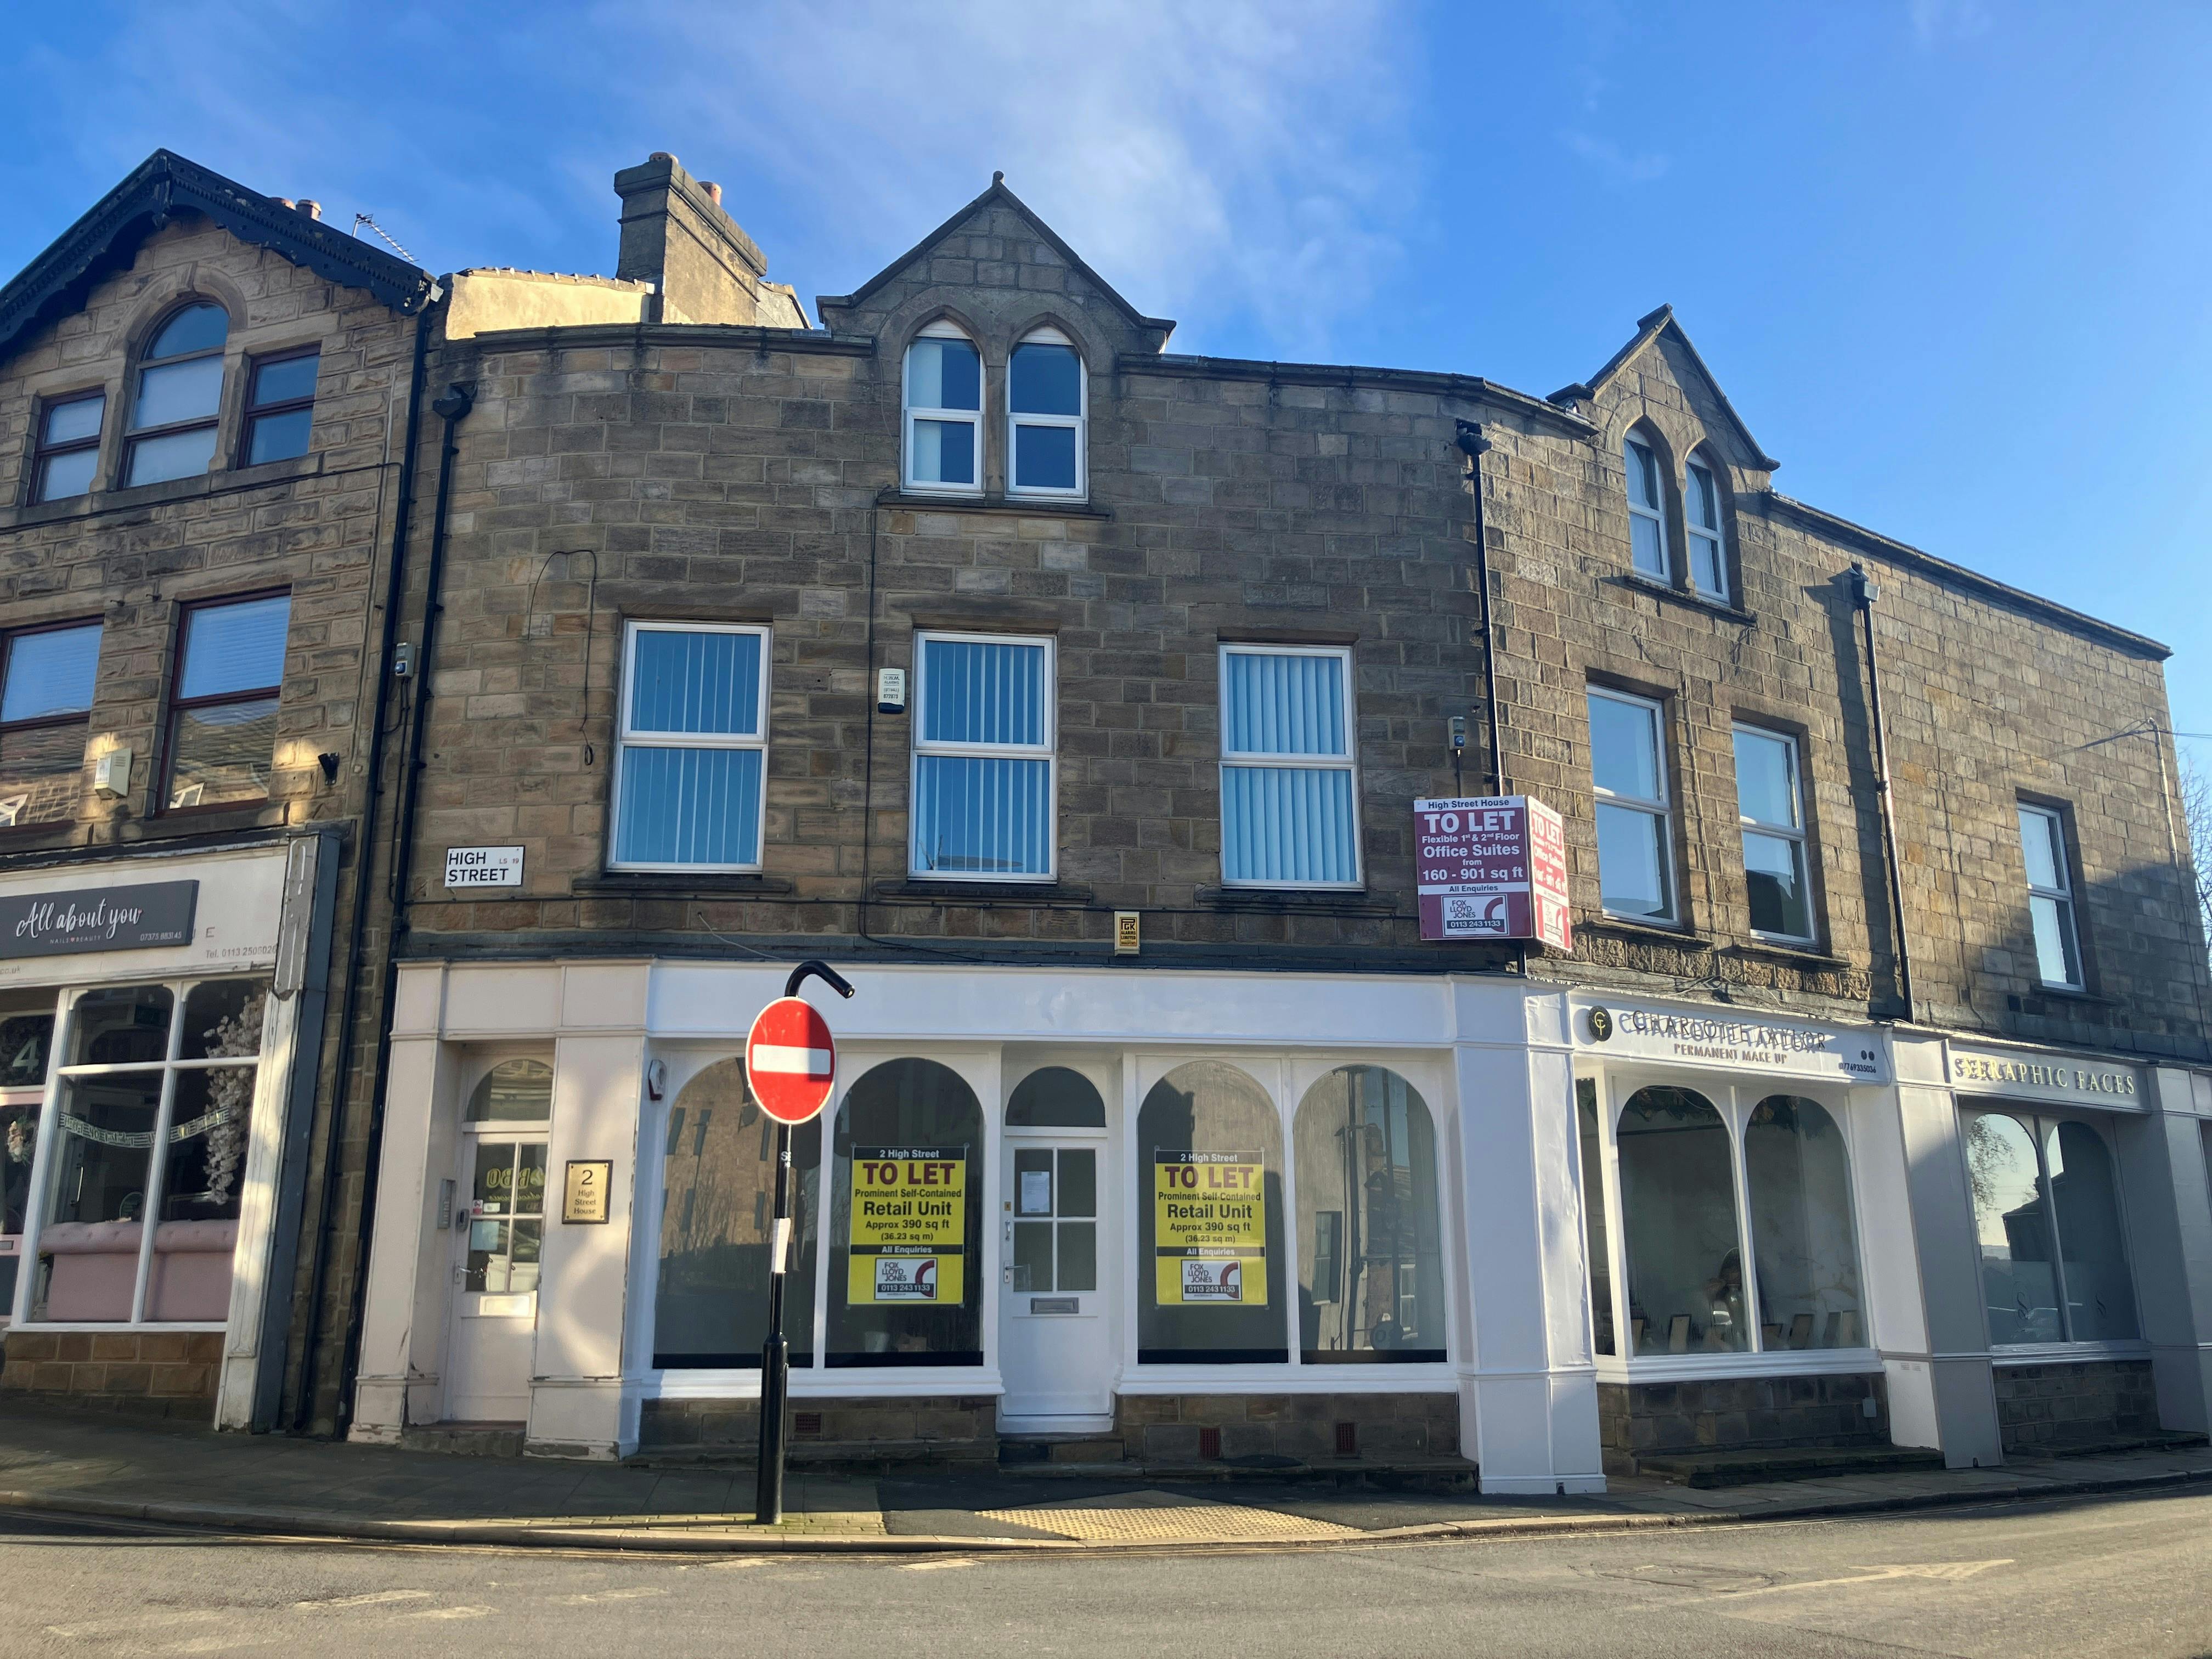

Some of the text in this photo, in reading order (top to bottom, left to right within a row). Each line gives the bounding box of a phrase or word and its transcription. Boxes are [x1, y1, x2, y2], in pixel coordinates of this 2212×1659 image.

[1428, 799, 1509, 810] High Street House
[1424, 812, 1459, 833] TO
[1468, 810, 1515, 832] LET
[1532, 812, 1544, 837] TO
[1545, 821, 1560, 845] LET
[1421, 834, 1458, 844] Flexible
[1461, 834, 1471, 842] 1st
[1481, 833, 1494, 841] 2nd
[1495, 833, 1520, 841] Floor
[1423, 845, 1468, 858] Office
[1472, 844, 1520, 856] Suites
[448, 851, 486, 865] HIGH
[448, 868, 509, 882] STREET
[1423, 869, 1447, 881] 160
[1460, 868, 1485, 879] 901
[1490, 869, 1508, 881] sq
[1512, 866, 1523, 878] ft
[1462, 885, 1498, 893] Enquiries
[16, 898, 142, 939] All about you
[206, 949, 219, 958] Tel.
[222, 947, 240, 957] 0113
[12, 1038, 40, 1074] 4
[1674, 1043, 1787, 1064] PERMANENT MAKE UP
[1963, 1057, 2134, 1094] SERAPHIC FACES
[888, 1149, 909, 1160] High
[912, 1149, 939, 1158] Street
[1188, 1153, 1209, 1163] High
[1211, 1154, 1238, 1162] Street
[582, 1169, 593, 1185] 2
[862, 1163, 956, 1185] TO LET
[1164, 1166, 1254, 1188] TO LET
[578, 1189, 595, 1198] High
[855, 1188, 962, 1198] Prominent Self-Contained
[1158, 1192, 1261, 1201] Prominent Self-Contained
[864, 1201, 952, 1216] Retail Unit
[1167, 1204, 1252, 1218] Retail Unit
[865, 1219, 950, 1231] Approx 390 sq ft
[1170, 1222, 1251, 1233] Approx 390 sq ft
[881, 1233, 907, 1241] (36.23
[922, 1233, 934, 1241] m)
[1185, 1235, 1210, 1244] (36.23
[1224, 1235, 1236, 1244] m)
[894, 1246, 932, 1255] Enquiries
[1199, 1248, 1235, 1257] Enquiries
